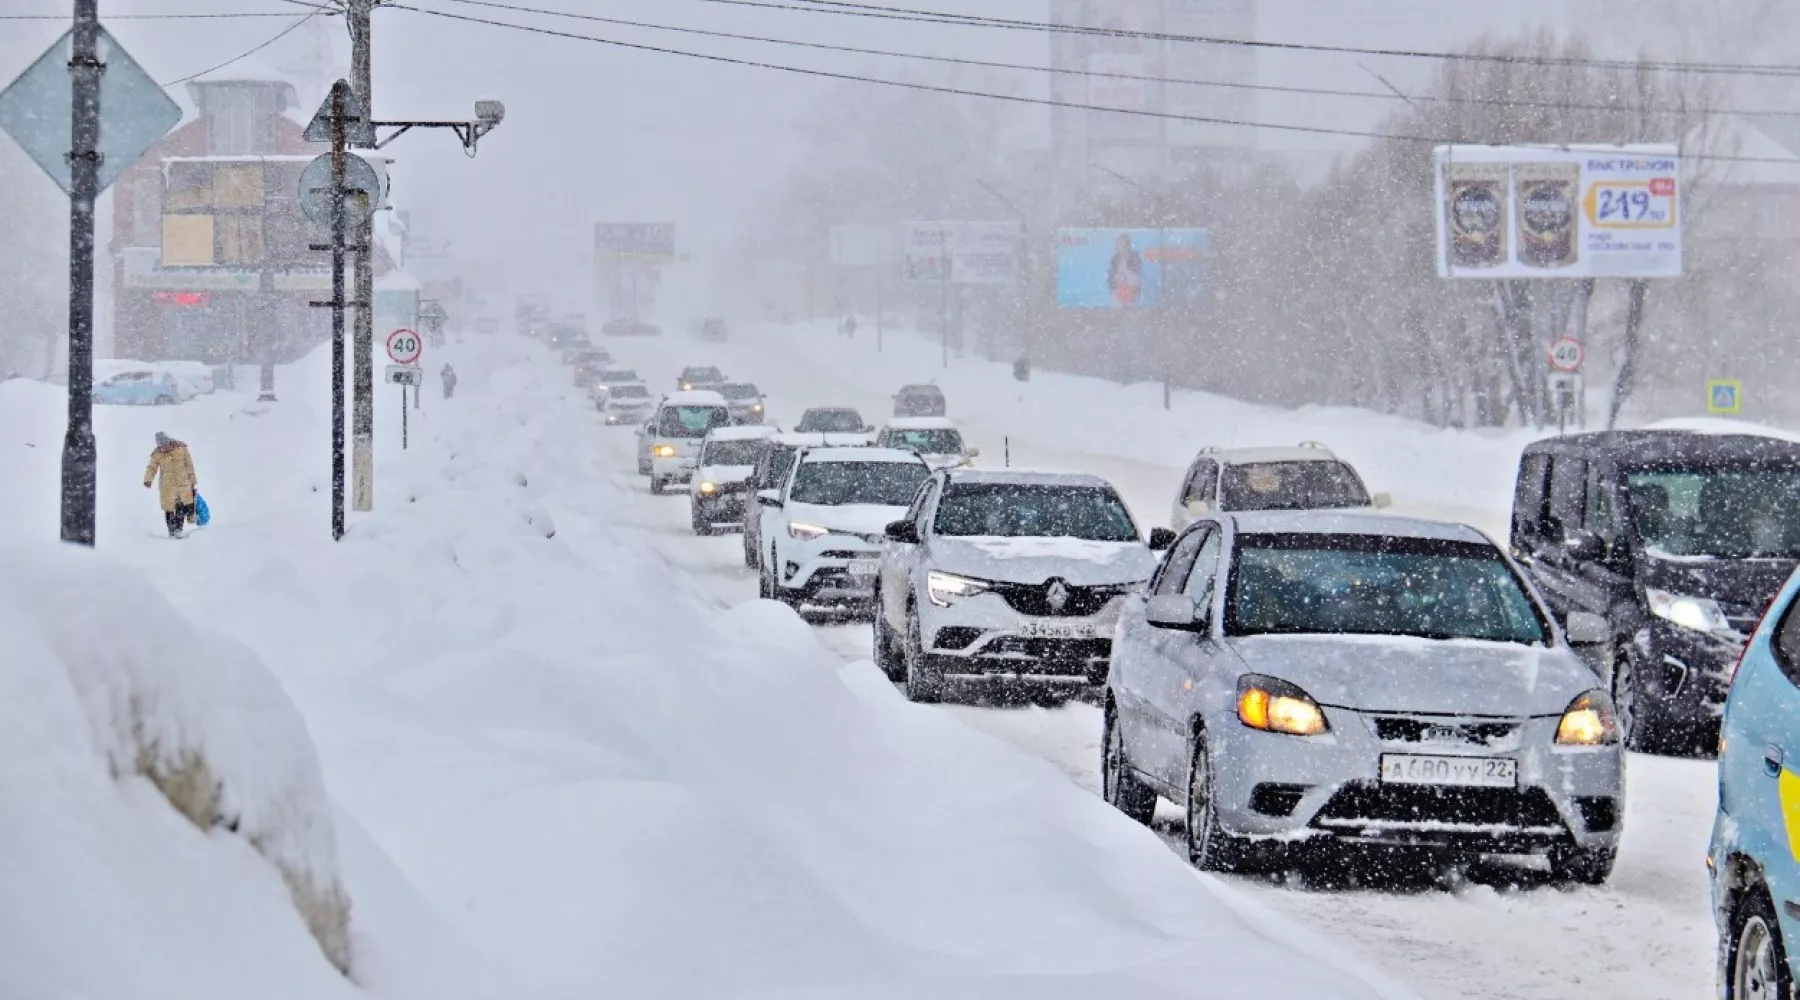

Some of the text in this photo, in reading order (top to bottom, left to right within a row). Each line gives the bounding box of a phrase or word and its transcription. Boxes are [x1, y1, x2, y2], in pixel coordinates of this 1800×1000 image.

[1599, 189, 1649, 220] 219
[393, 338, 415, 352] 40
[1556, 346, 1577, 361] 40
[1485, 760, 1507, 778] 22
